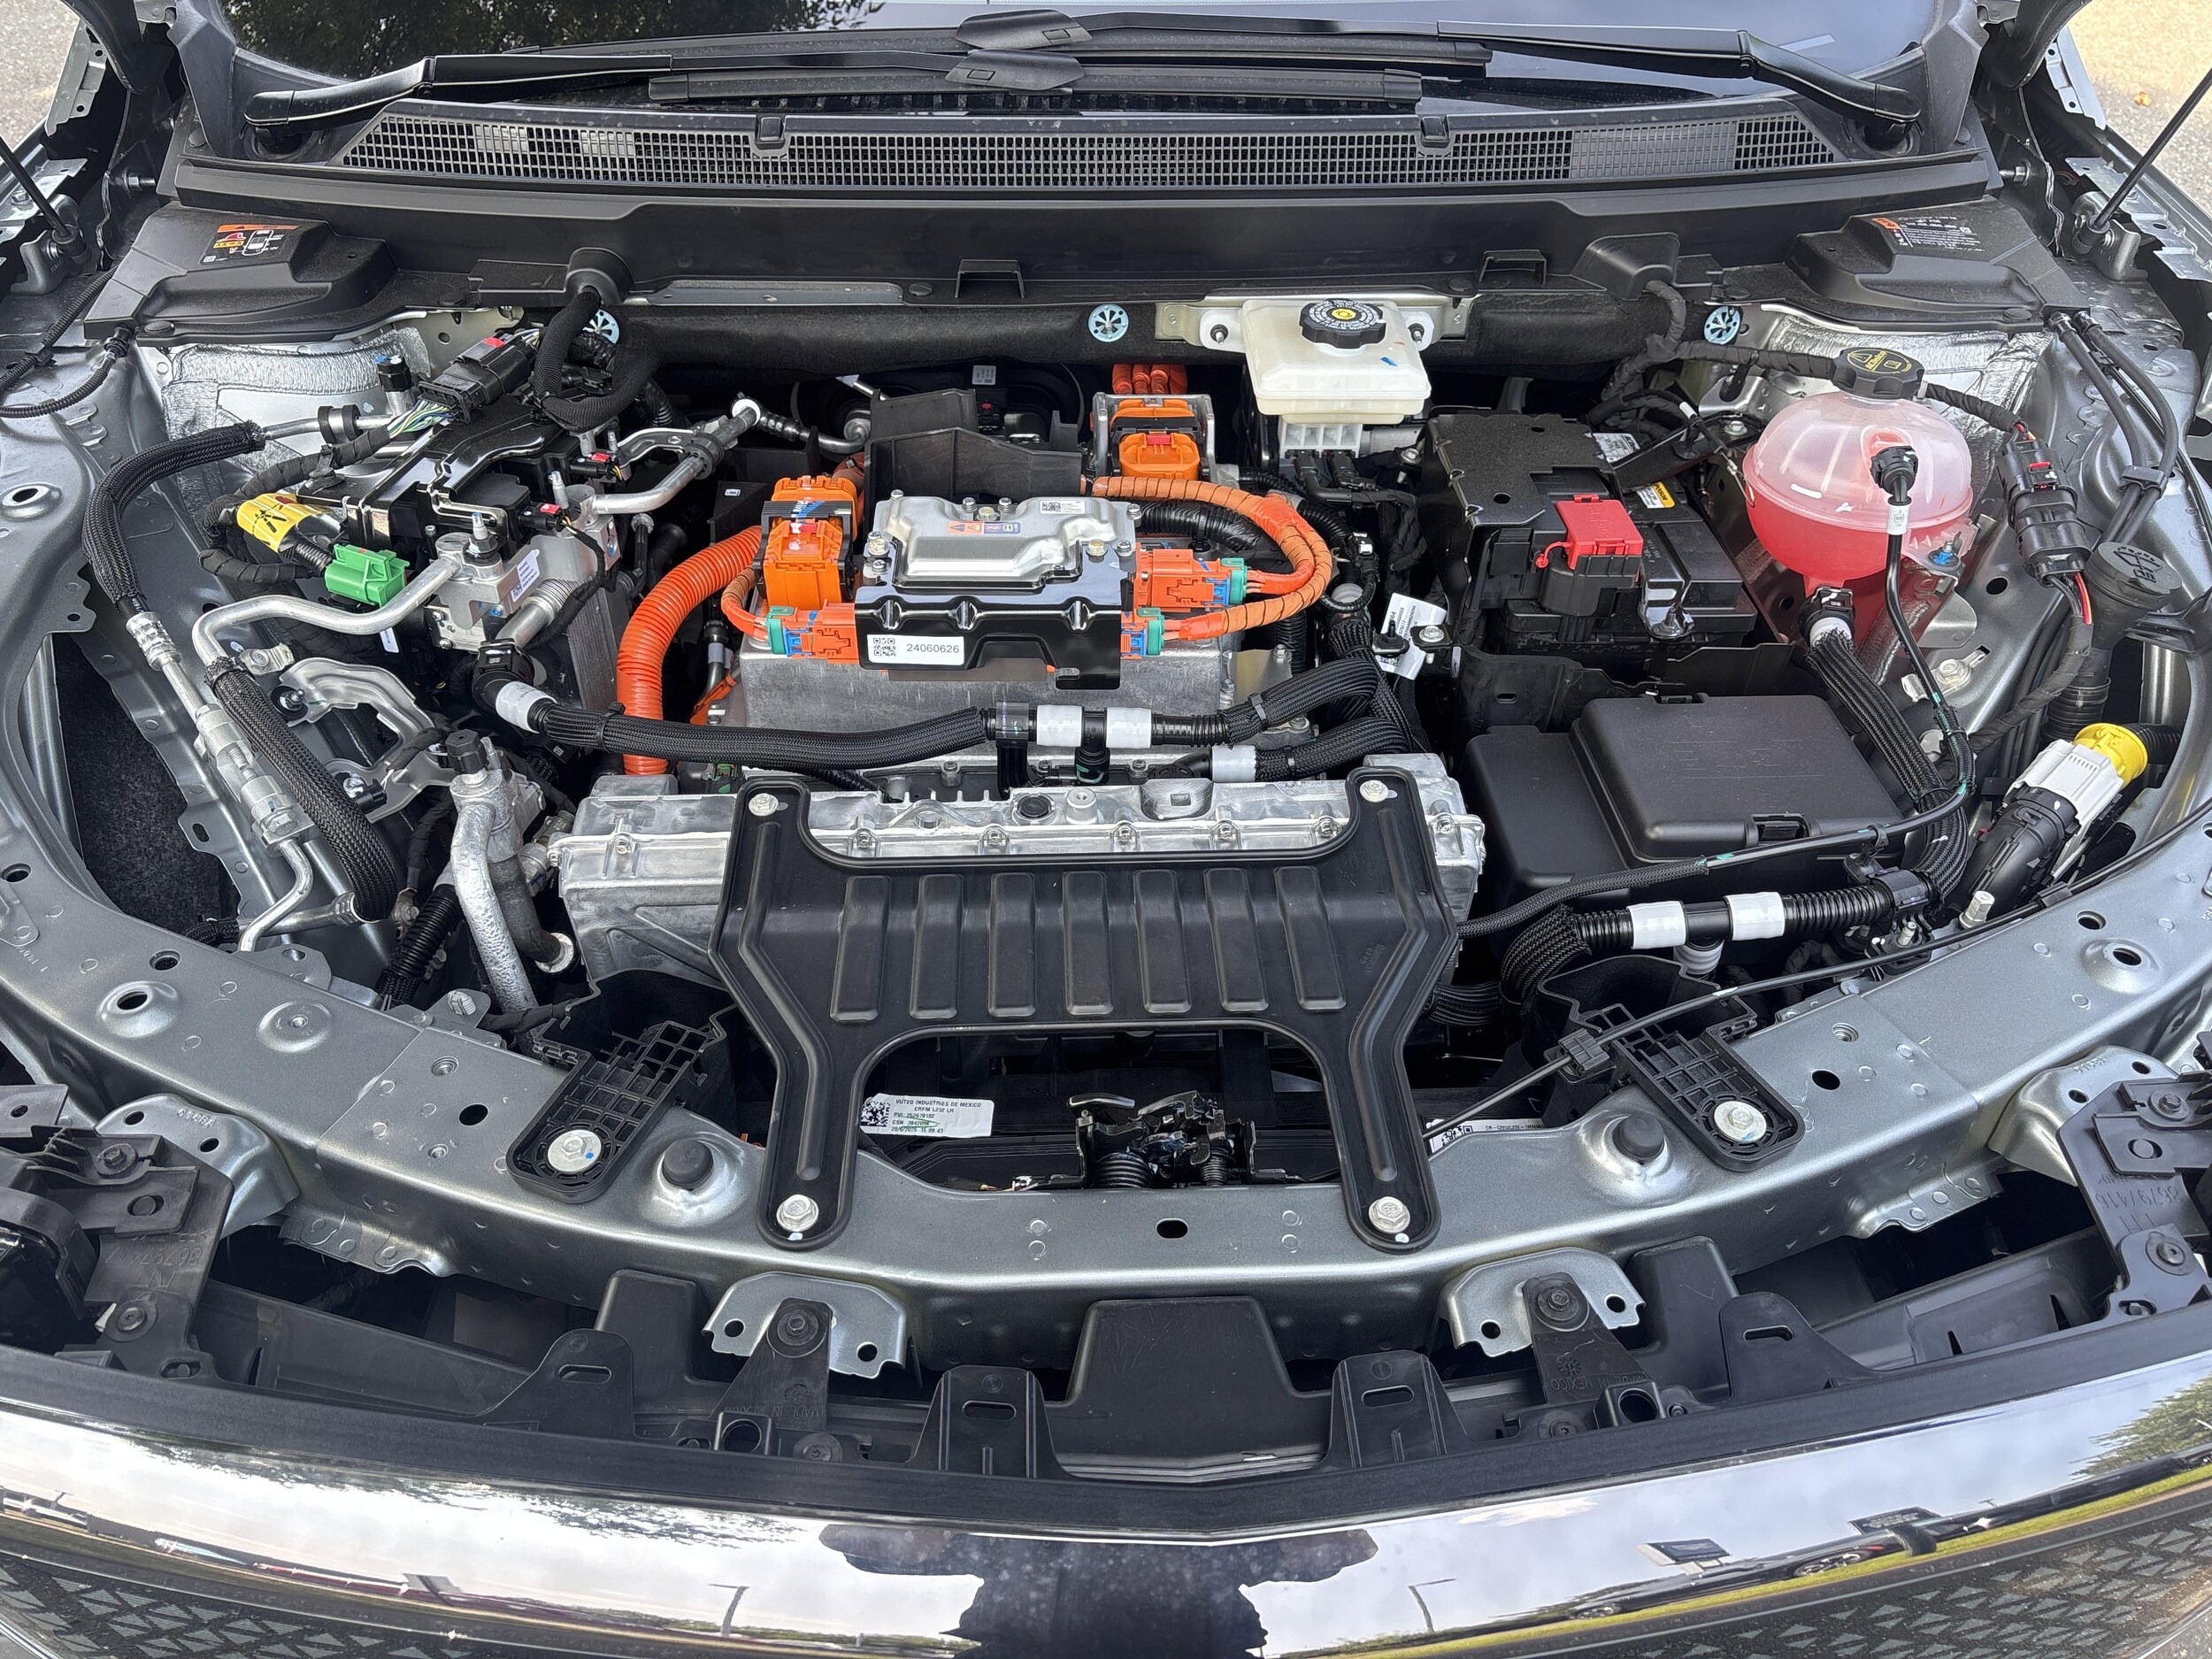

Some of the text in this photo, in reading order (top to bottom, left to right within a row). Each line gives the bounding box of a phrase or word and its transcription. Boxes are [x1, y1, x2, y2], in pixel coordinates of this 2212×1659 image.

[906, 643, 960, 654] 24060626
[1550, 1376, 1593, 1391] MEXICO
[1598, 1377, 1609, 1386] IN
[772, 1406, 783, 1417] IN
[788, 1405, 820, 1417] MADE
